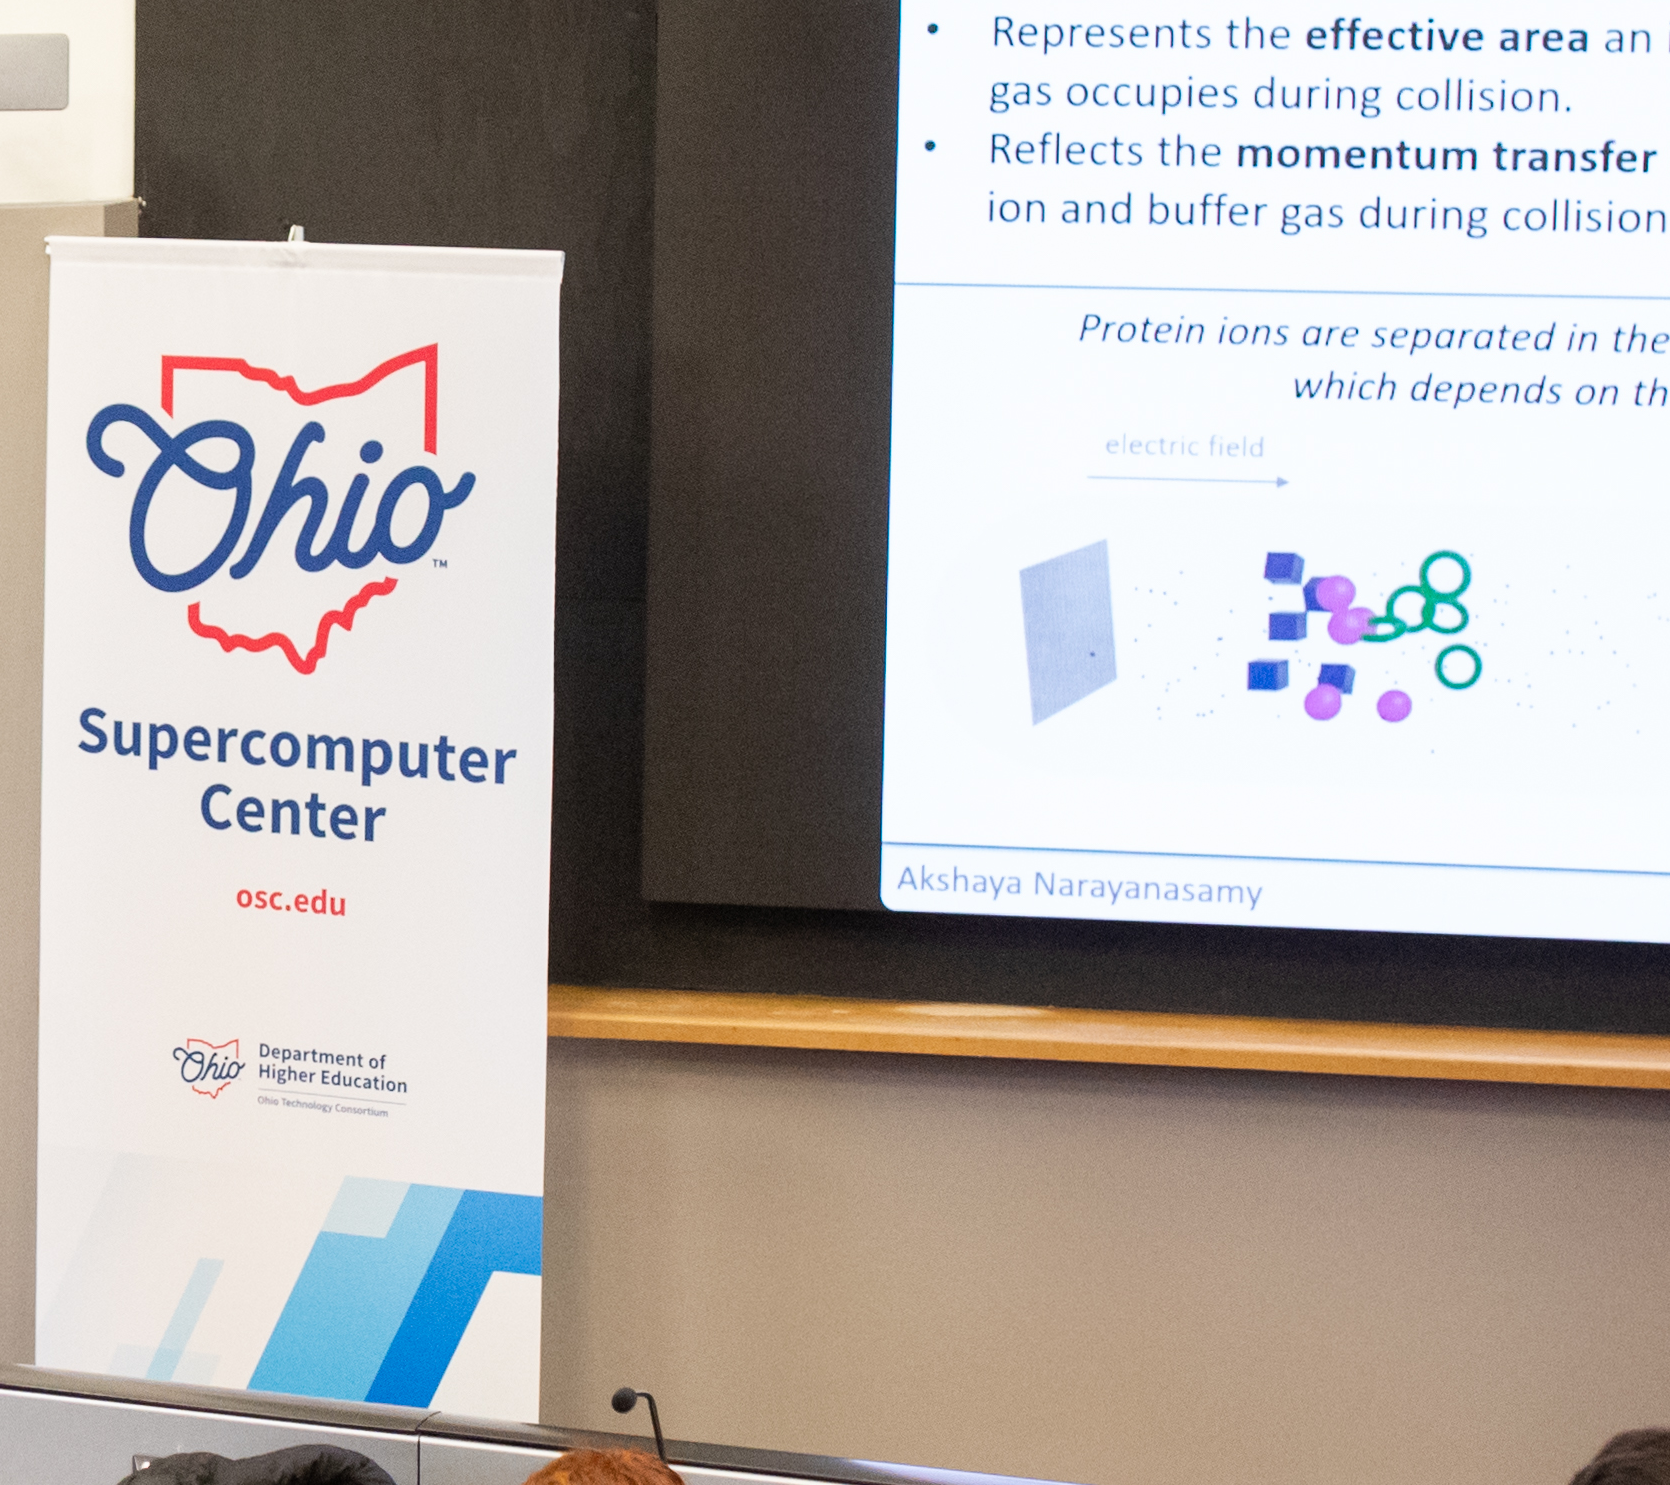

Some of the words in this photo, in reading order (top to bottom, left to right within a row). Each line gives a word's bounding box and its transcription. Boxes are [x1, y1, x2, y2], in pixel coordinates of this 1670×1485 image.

[993, 16, 1212, 56] Represents
[1226, 16, 1291, 50] the
[1305, 16, 1485, 53] effective
[1498, 28, 1589, 53] area
[1604, 28, 1652, 54] an
[990, 131, 1144, 166] Reflects
[1158, 134, 1222, 168] the
[1237, 140, 1478, 172] momentum
[1492, 139, 1658, 173] transfer
[1078, 313, 1206, 344] Protein
[1217, 323, 1289, 346] ions
[1301, 325, 1361, 348] are
[1371, 322, 1557, 356] separated
[1566, 330, 1599, 352] in
[1612, 323, 1670, 355] the
[1104, 434, 1199, 457] electric
[1208, 434, 1265, 458] field
[86, 403, 477, 593] Ohio
[78, 707, 518, 787] Supercomputer
[200, 783, 387, 842] Center
[235, 888, 346, 917] osc.edu
[896, 864, 1022, 901] Akshaya
[1033, 870, 1264, 912] Narayanasamy
[173, 1047, 246, 1083] Ohio
[259, 1043, 363, 1068] Department
[368, 1055, 387, 1070] of
[258, 1064, 316, 1084] Higher
[321, 1070, 408, 1093] Education
[257, 1096, 279, 1106] Ohio
[282, 1098, 333, 1113] Technology
[335, 1103, 389, 1117] Consortium
